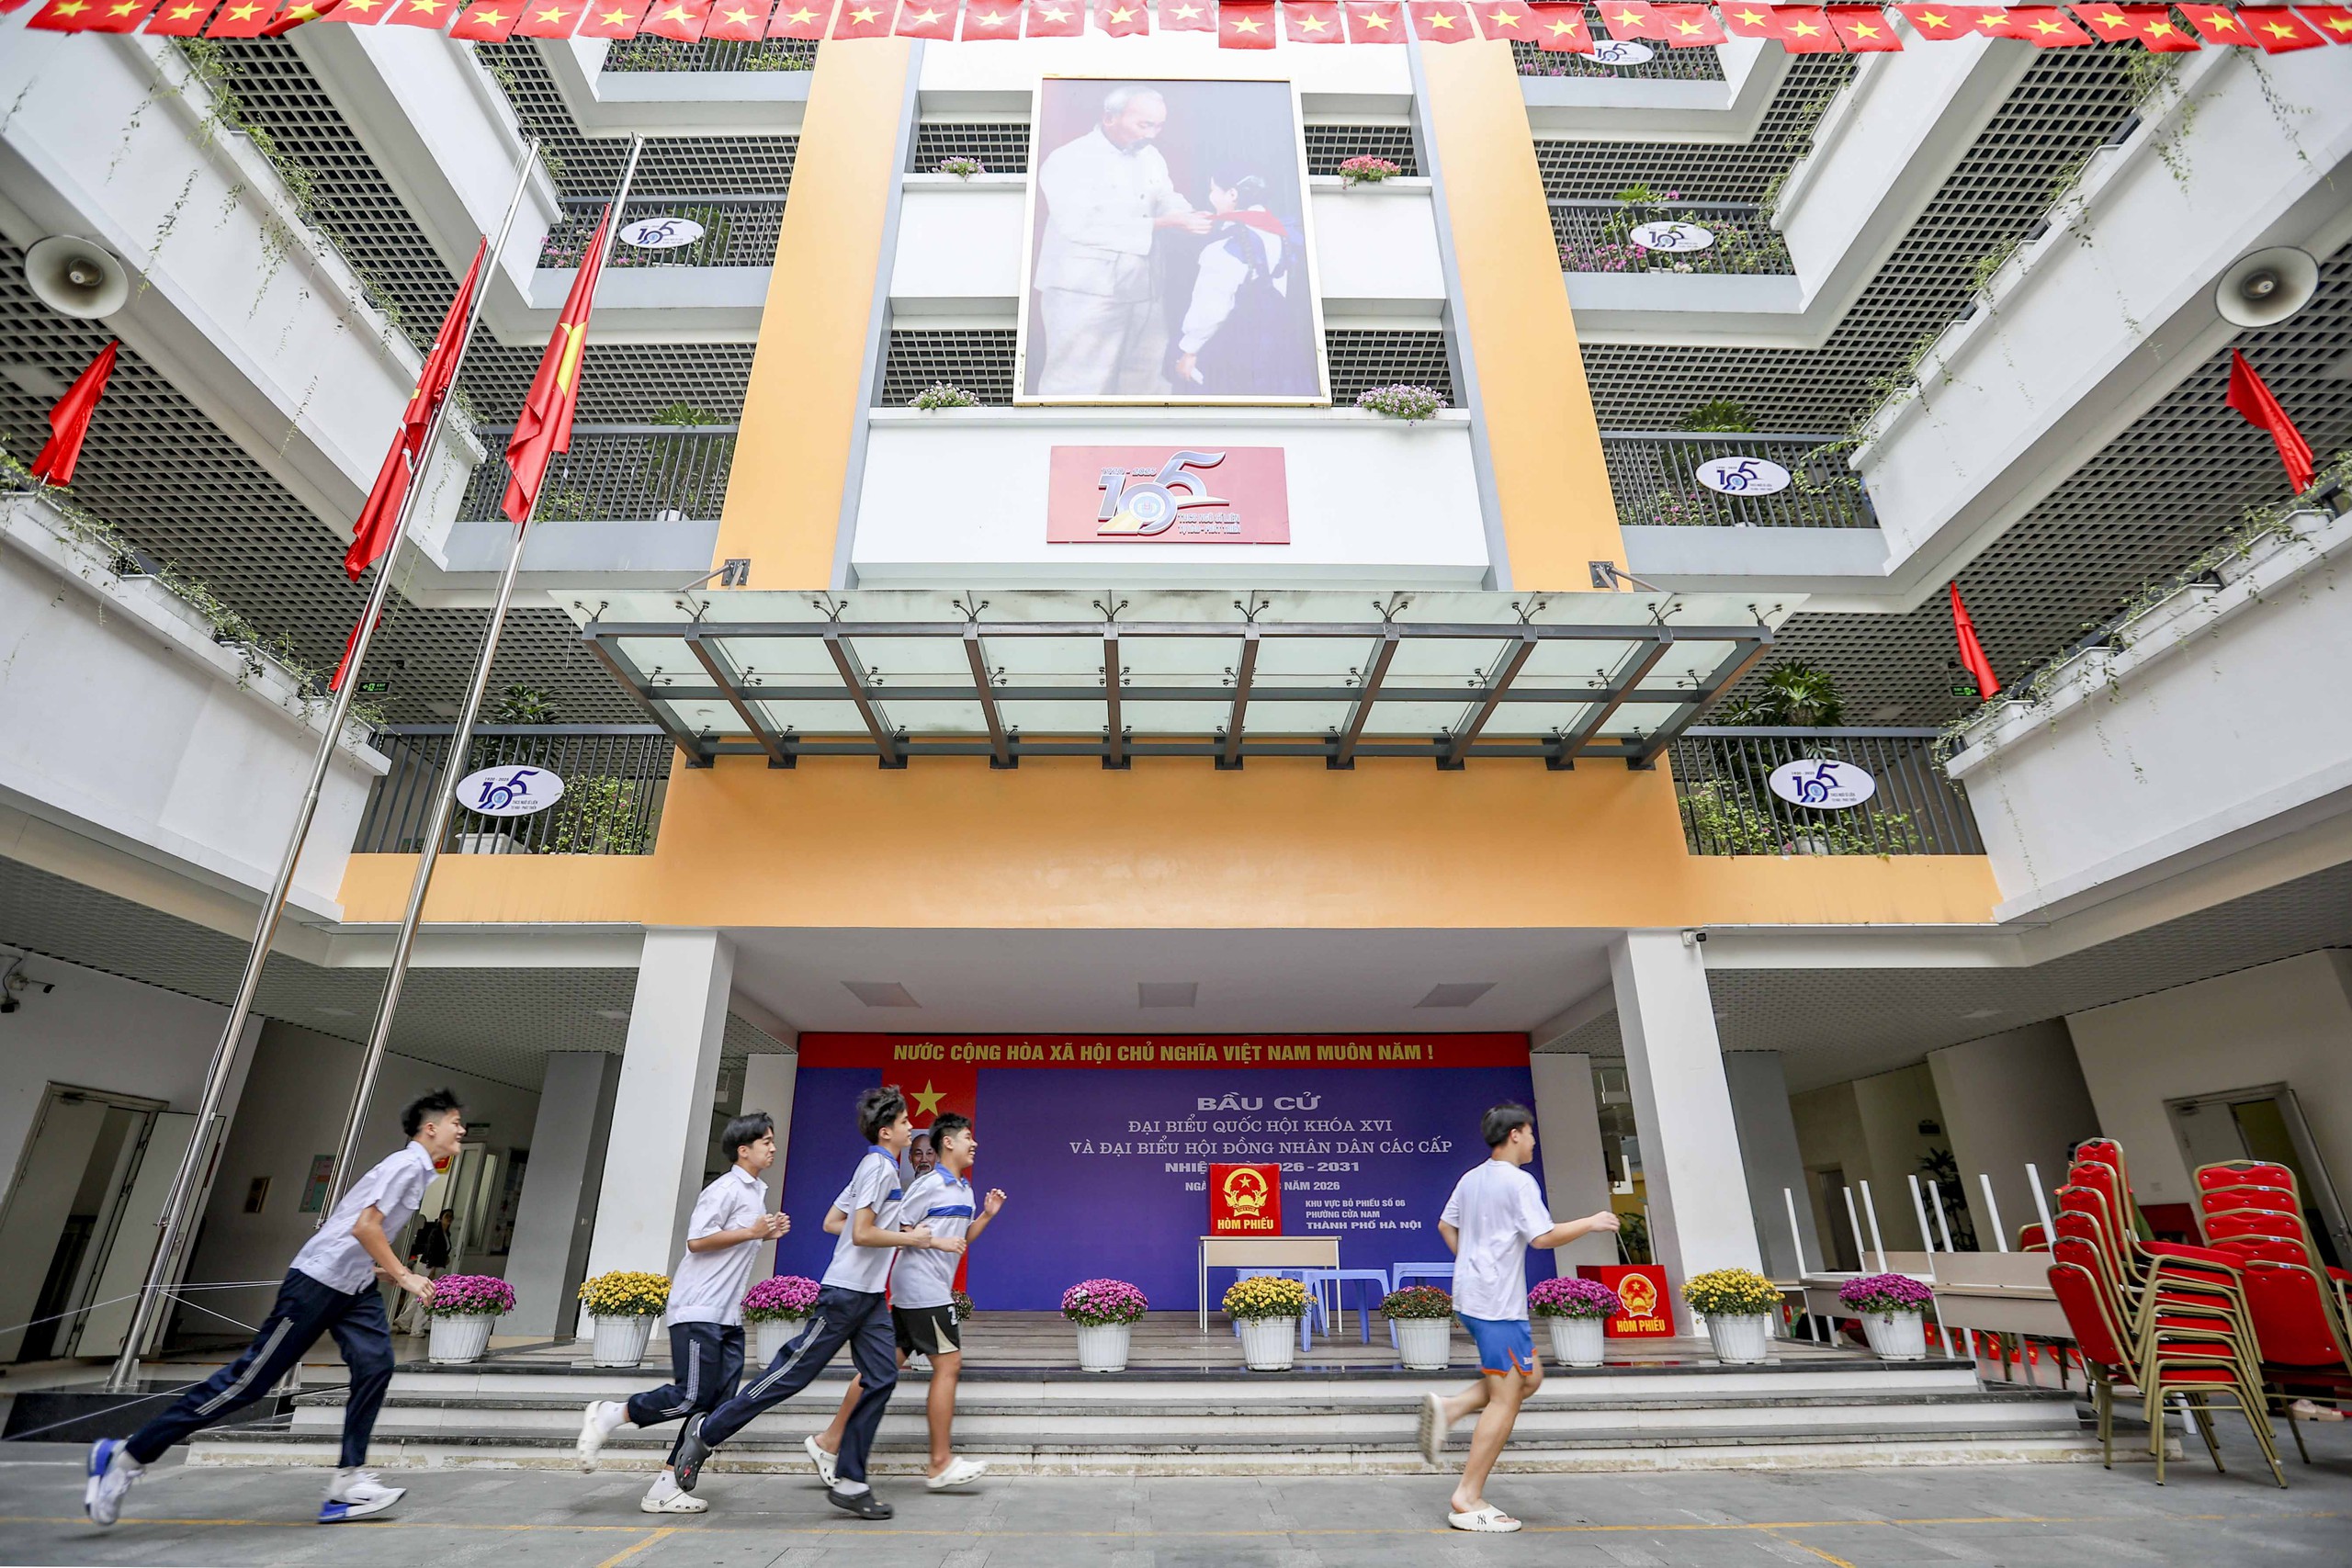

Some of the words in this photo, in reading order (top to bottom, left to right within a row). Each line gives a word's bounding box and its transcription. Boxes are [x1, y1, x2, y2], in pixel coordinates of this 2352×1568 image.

[893, 1042, 944, 1061] NƯỚC
[950, 1042, 1001, 1064] CỘNG
[1007, 1042, 1044, 1061] HÒA
[1049, 1042, 1075, 1061] XÃ
[1080, 1043, 1112, 1064] HỘI
[1117, 1041, 1155, 1061] CHỦ
[1160, 1043, 1218, 1061] NGHĨA
[1223, 1043, 1262, 1064] VIỆT
[1268, 1045, 1310, 1061] NAM
[1317, 1043, 1373, 1061] MUÔN
[1378, 1042, 1421, 1060] NĂM
[1197, 1091, 1262, 1111] BẦU
[1273, 1091, 1321, 1111] CỬ
[1128, 1121, 1160, 1135] ĐẠI
[1165, 1113, 1207, 1133] BIỂU
[1213, 1115, 1261, 1134] QUỐC
[1266, 1117, 1298, 1134] HỘI
[1304, 1117, 1355, 1132] KHÓA
[1360, 1120, 1393, 1132] XVI
[1069, 1139, 1094, 1154] VÀ
[1099, 1142, 1132, 1157] ĐẠI
[1137, 1135, 1180, 1154] BIỂU
[1185, 1139, 1217, 1156] HỘI
[1223, 1136, 1274, 1154] ĐỒNG
[1279, 1138, 1330, 1154] NHÂN
[1336, 1138, 1374, 1154] DÂN
[1380, 1137, 1414, 1153] CÁC
[1419, 1135, 1453, 1153] CẤP
[1165, 1161, 1207, 1174] NHIỆ
[1317, 1162, 1360, 1172] 2031
[1185, 1180, 1206, 1190] NGÀ
[1284, 1180, 1310, 1190] NĂM
[1314, 1181, 1340, 1190] 2026
[1324, 1200, 1340, 1209] VỰC
[1342, 1198, 1353, 1207] BỎ
[1356, 1198, 1380, 1207] PHIẾU
[1382, 1198, 1393, 1207] SỐ
[1395, 1199, 1406, 1207] 06
[1306, 1209, 1340, 1218] PHƯỜNG
[1341, 1209, 1358, 1218] CỬA
[1217, 1217, 1240, 1229] HÒM
[1244, 1216, 1273, 1229] PHIẾU
[1306, 1220, 1348, 1229] THÀNH
[1351, 1220, 1376, 1229] PHỐ
[1380, 1220, 1396, 1229] HÀ
[1400, 1220, 1422, 1230] NỘI
[1617, 1317, 1637, 1332] HÒM
[1639, 1316, 1666, 1332] PHIẾU
